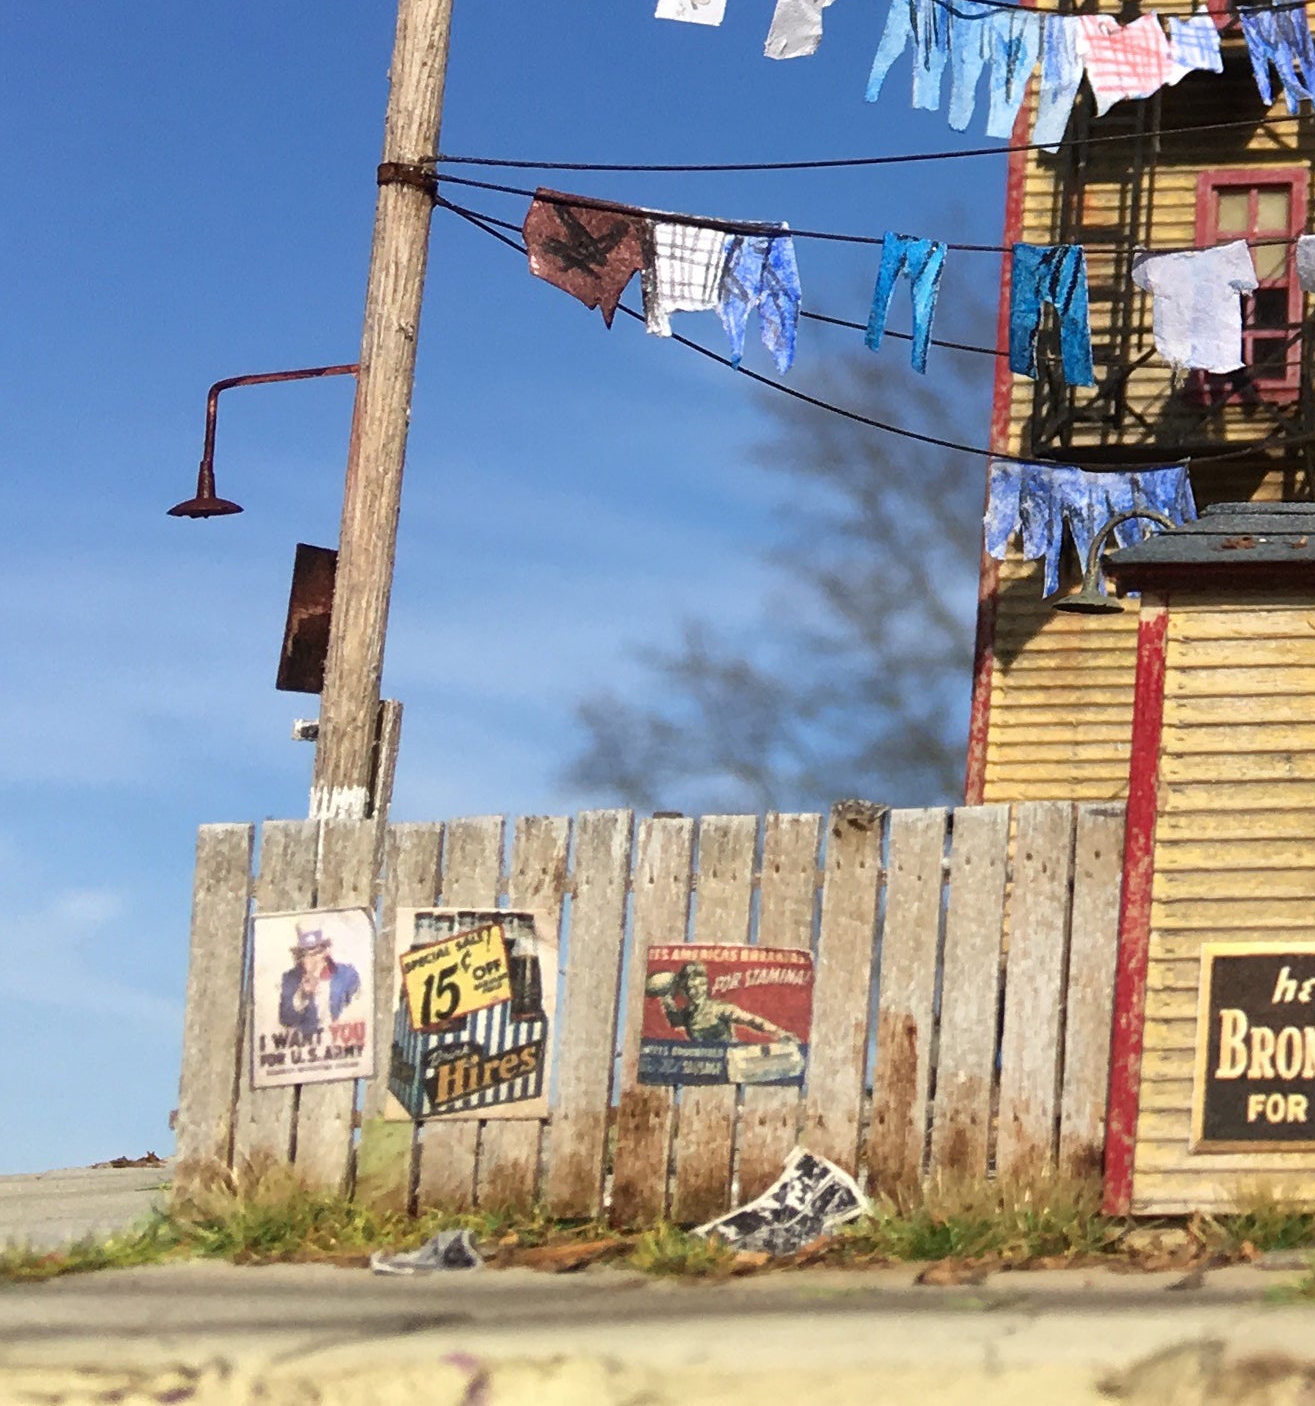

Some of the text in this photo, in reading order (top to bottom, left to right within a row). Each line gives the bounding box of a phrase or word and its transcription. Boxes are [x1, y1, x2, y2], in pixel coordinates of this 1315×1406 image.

[271, 1027, 324, 1049] WANT
[329, 1020, 366, 1047] YOU
[435, 1045, 537, 1104] Hires
[1247, 1093, 1309, 1124] FOR
